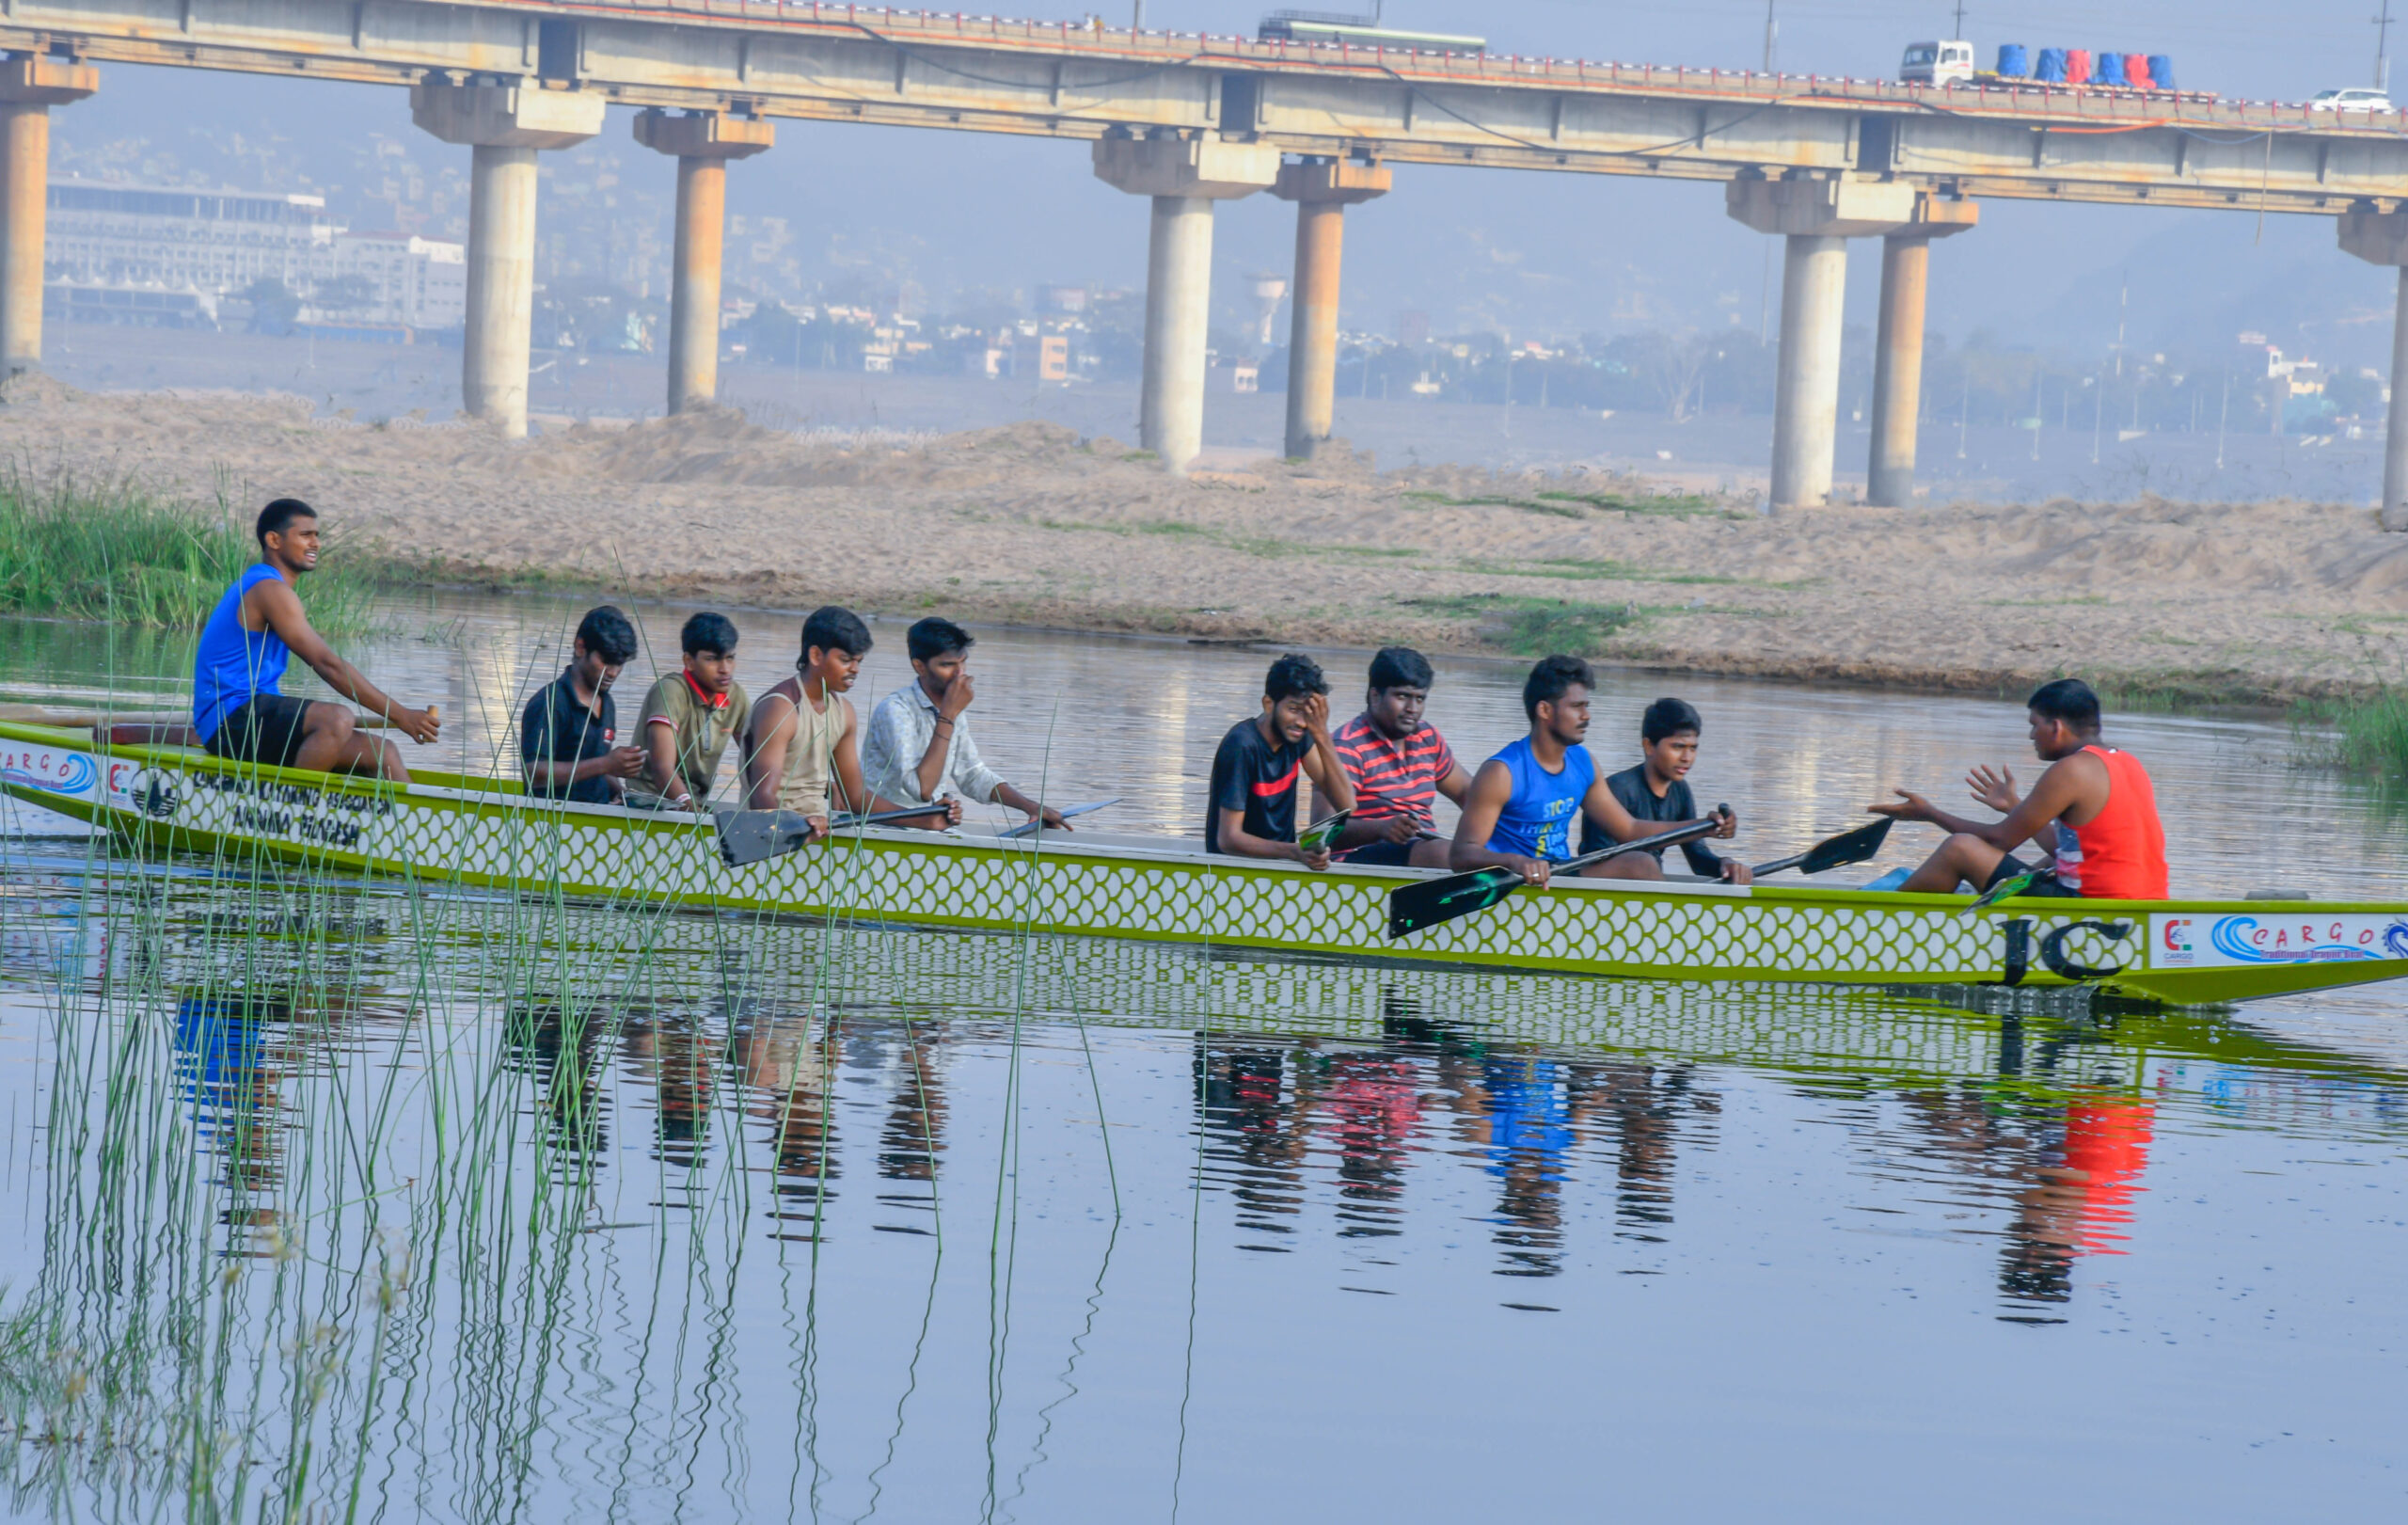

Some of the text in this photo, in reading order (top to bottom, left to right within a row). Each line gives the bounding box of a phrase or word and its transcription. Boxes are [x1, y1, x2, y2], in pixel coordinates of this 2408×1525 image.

[0, 753, 70, 777] ARGO
[1544, 797, 1574, 818] STOP
[2253, 922, 2373, 948] CARGO
